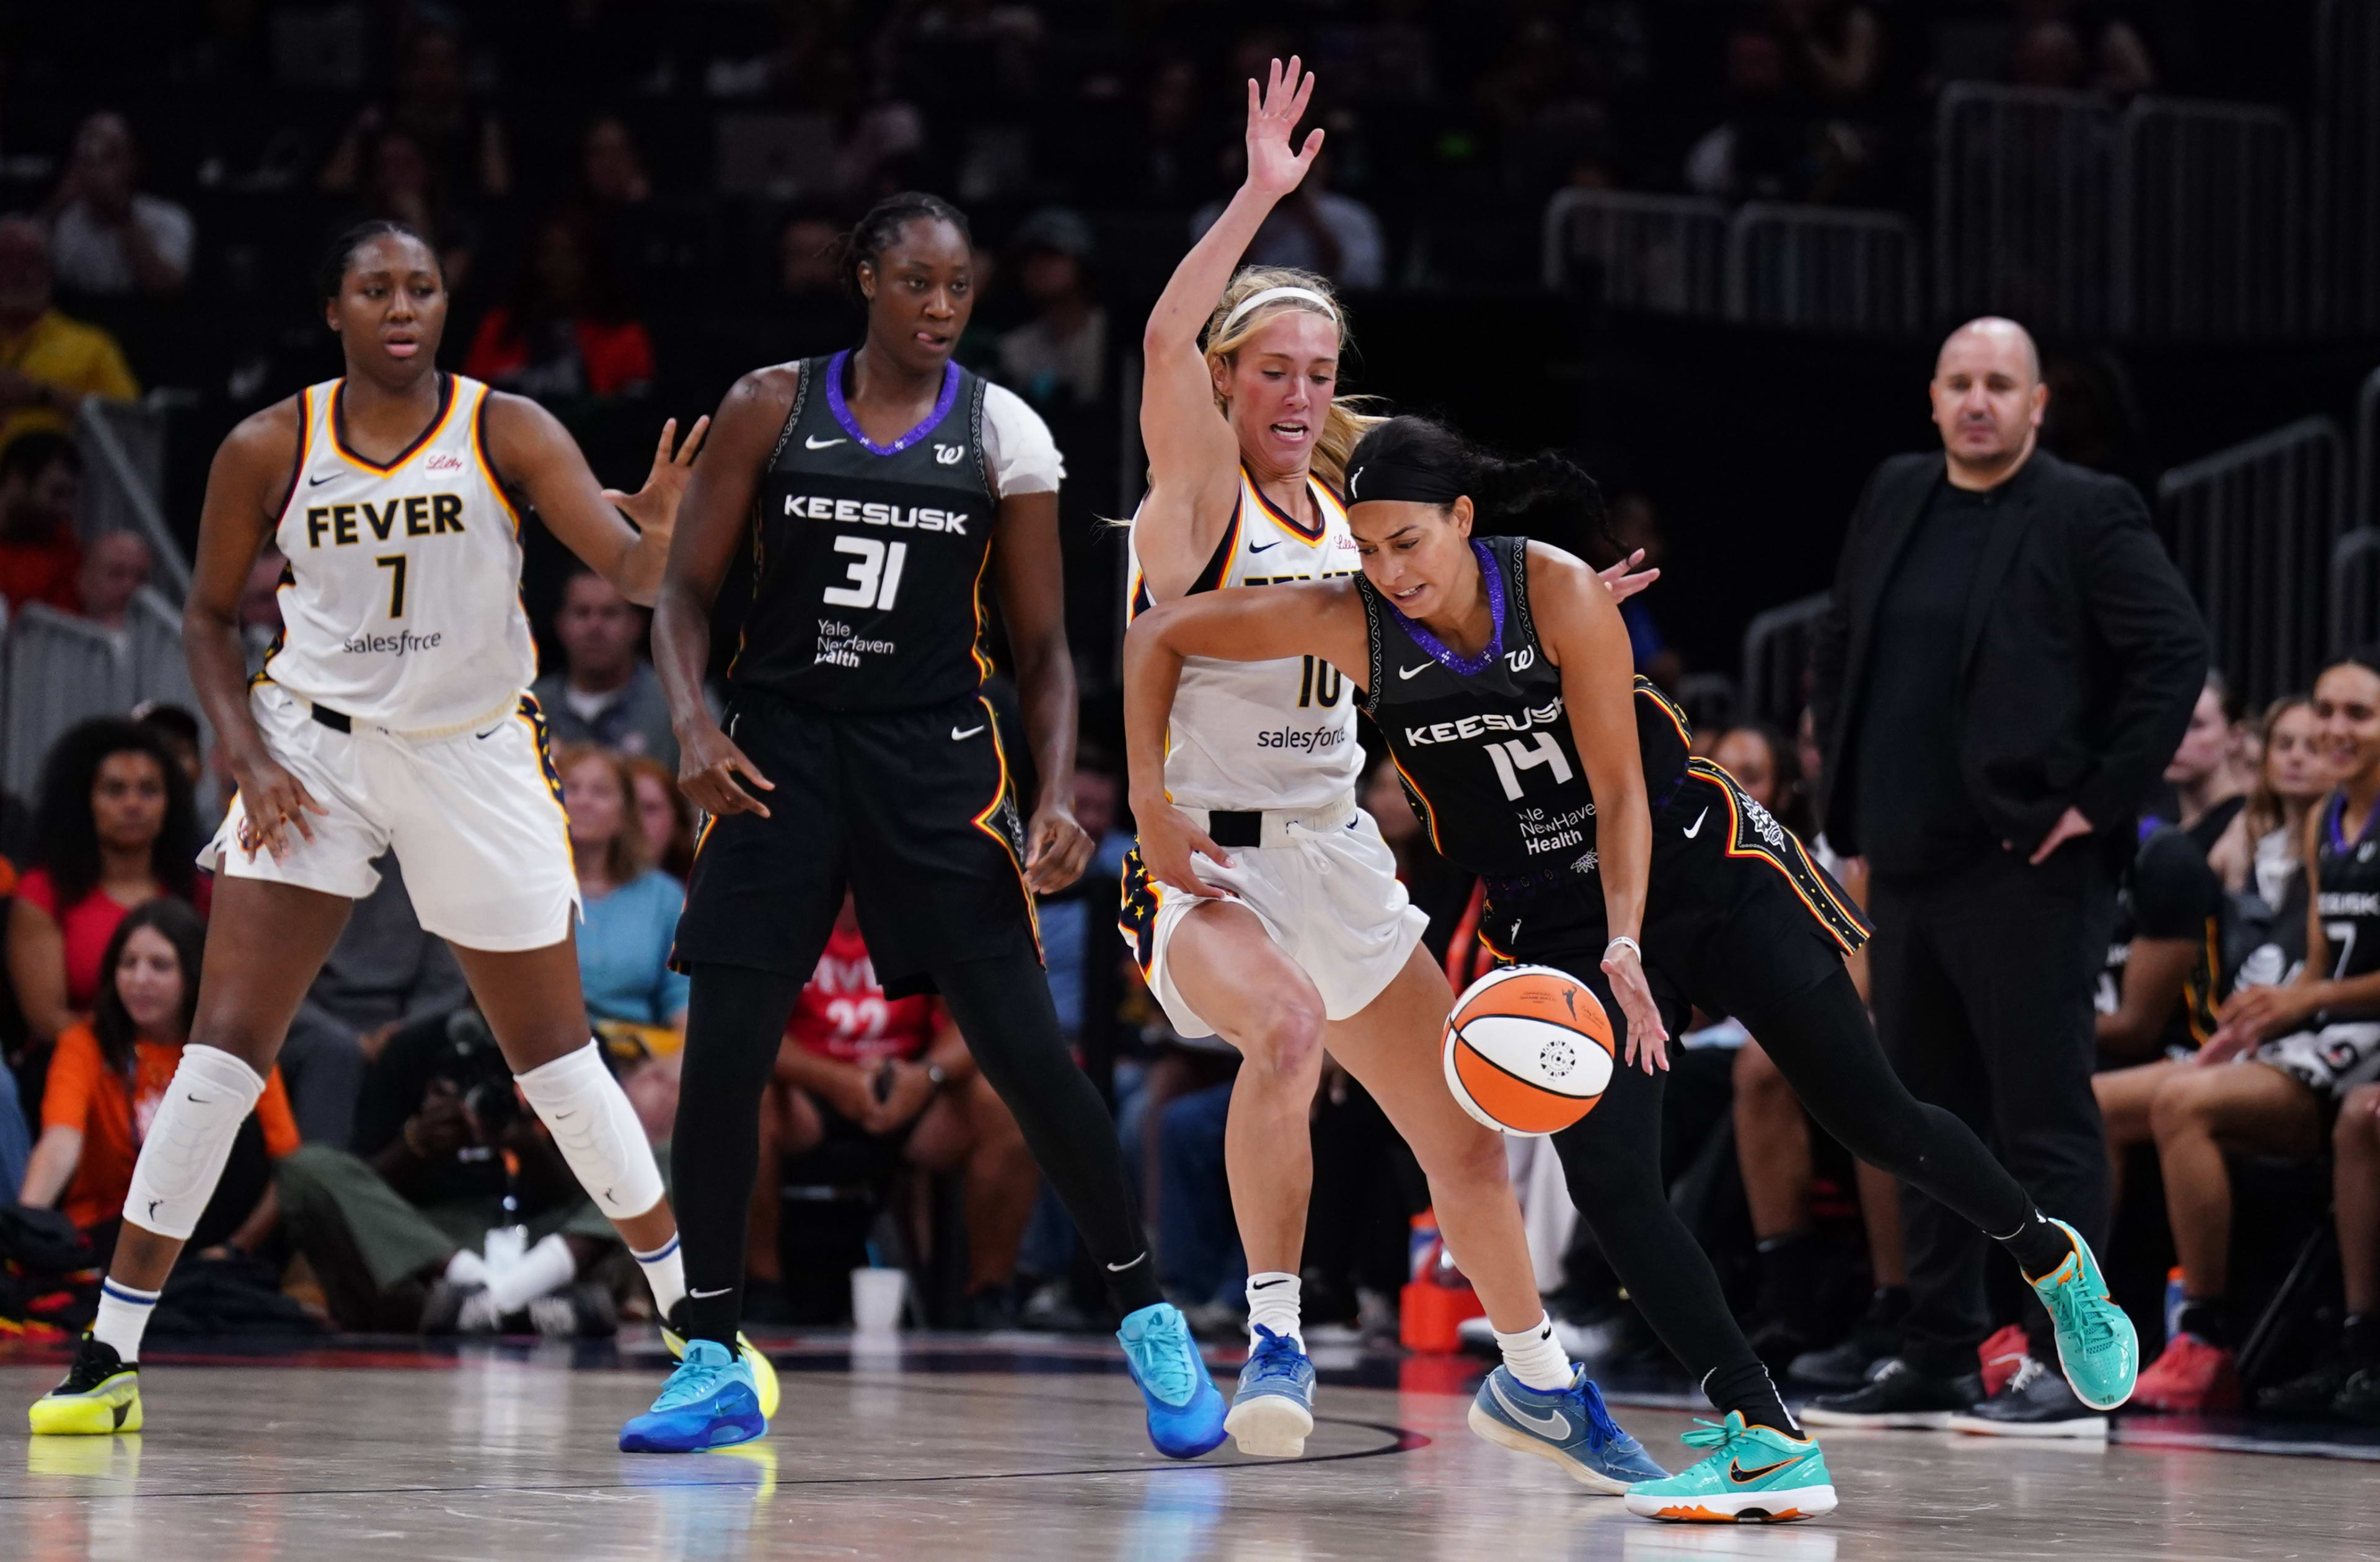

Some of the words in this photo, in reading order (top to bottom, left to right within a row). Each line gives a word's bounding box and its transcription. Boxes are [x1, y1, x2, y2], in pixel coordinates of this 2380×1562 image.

[307, 493, 465, 548] FEVER
[784, 494, 969, 536] KEESUSK
[1333, 534, 1357, 554] Lilly
[376, 554, 407, 619] 7
[823, 535, 907, 611] 31
[818, 619, 850, 637] Yale
[818, 635, 894, 655] NeHaven
[814, 650, 860, 668] alth
[1297, 655, 1341, 708] 10
[1257, 726, 1344, 754] salesforce
[1483, 731, 1573, 801] 14
[1520, 803, 1597, 837] NewHave
[1525, 829, 1583, 855] Health
[2326, 921, 2356, 982] 7
